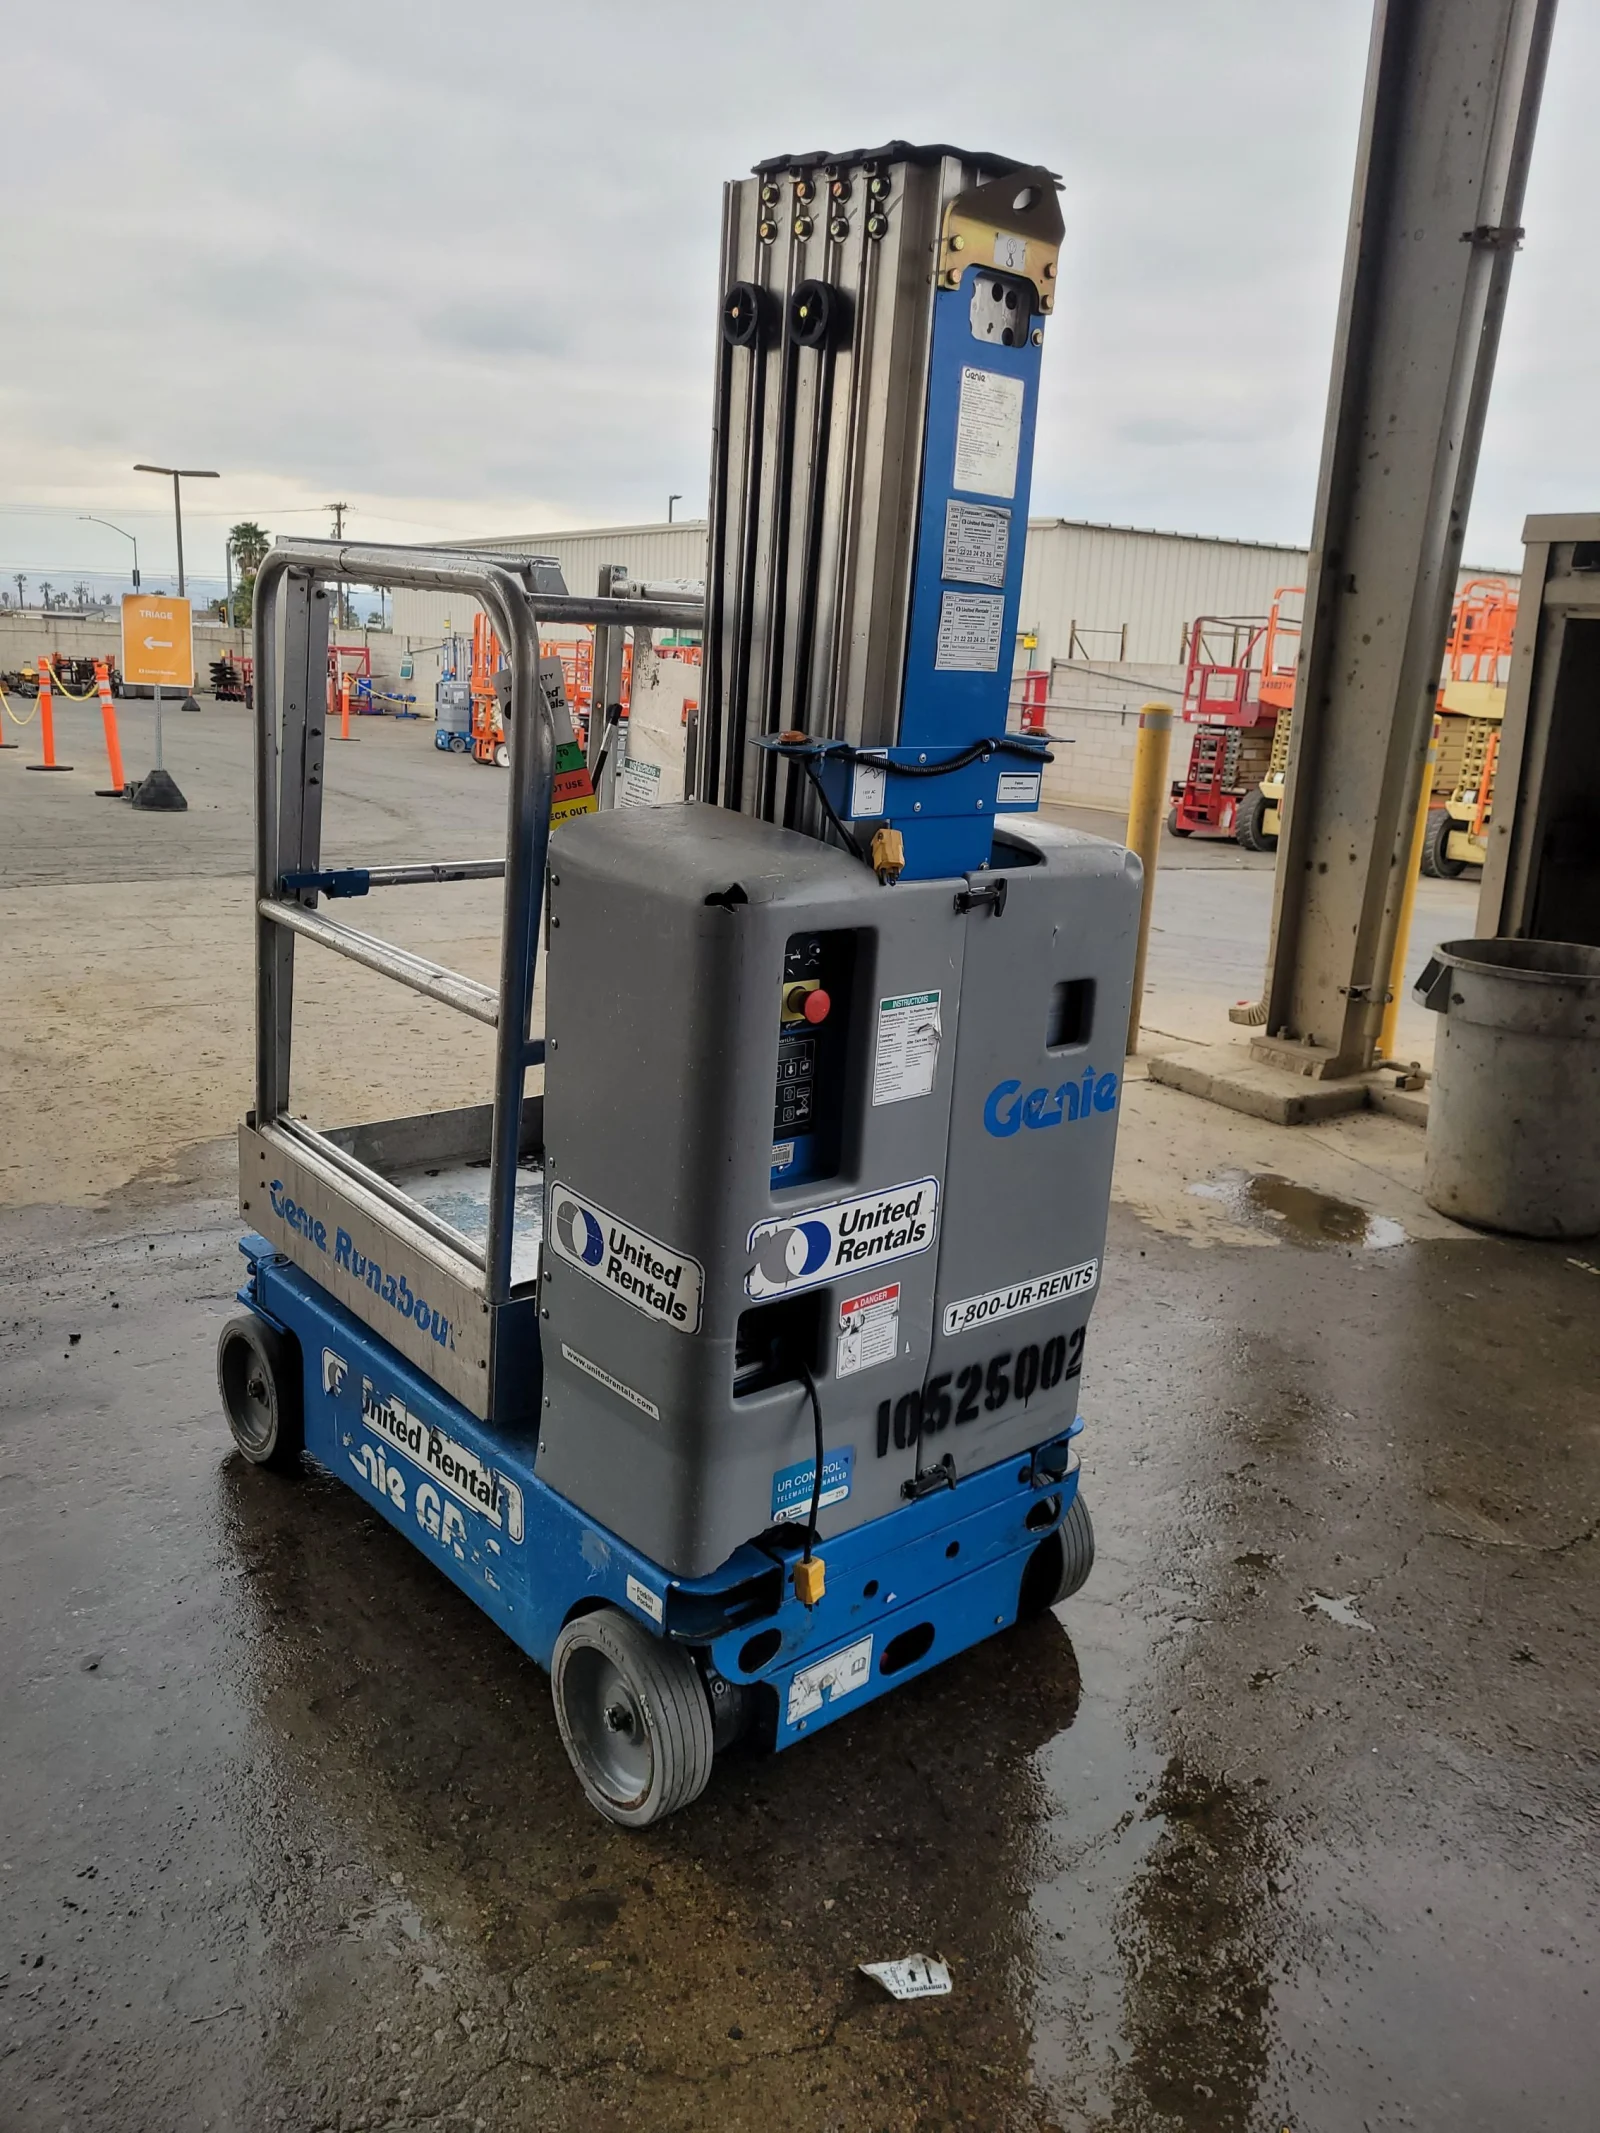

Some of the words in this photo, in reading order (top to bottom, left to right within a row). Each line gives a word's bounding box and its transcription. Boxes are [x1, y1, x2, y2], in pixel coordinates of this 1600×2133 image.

[964, 368, 985, 382] Genie
[140, 609, 172, 620] TRIAGE
[553, 784, 563, 792] OT
[565, 779, 584, 790] USE
[550, 811, 568, 821] ECK
[570, 806, 588, 816] OUT
[893, 996, 928, 1008] INSTRUCTIONS
[984, 1064, 1118, 1138] Genie
[270, 1179, 327, 1252] Genie
[839, 1191, 923, 1237] United
[835, 1220, 926, 1266] Rentals
[608, 1228, 682, 1290] United
[606, 1255, 688, 1322] Rentals
[860, 1291, 888, 1307] DANGER
[949, 1265, 1094, 1328] 1-800-UR-RENTS
[566, 1350, 654, 1413] www.unitedrentals.com
[777, 1485, 814, 1503] TELEMATIC
[822, 1472, 847, 1486] NABLED
[778, 1480, 792, 1492] UR
[794, 1461, 841, 1486] CONROL
[906, 1983, 947, 1993] Emergency
